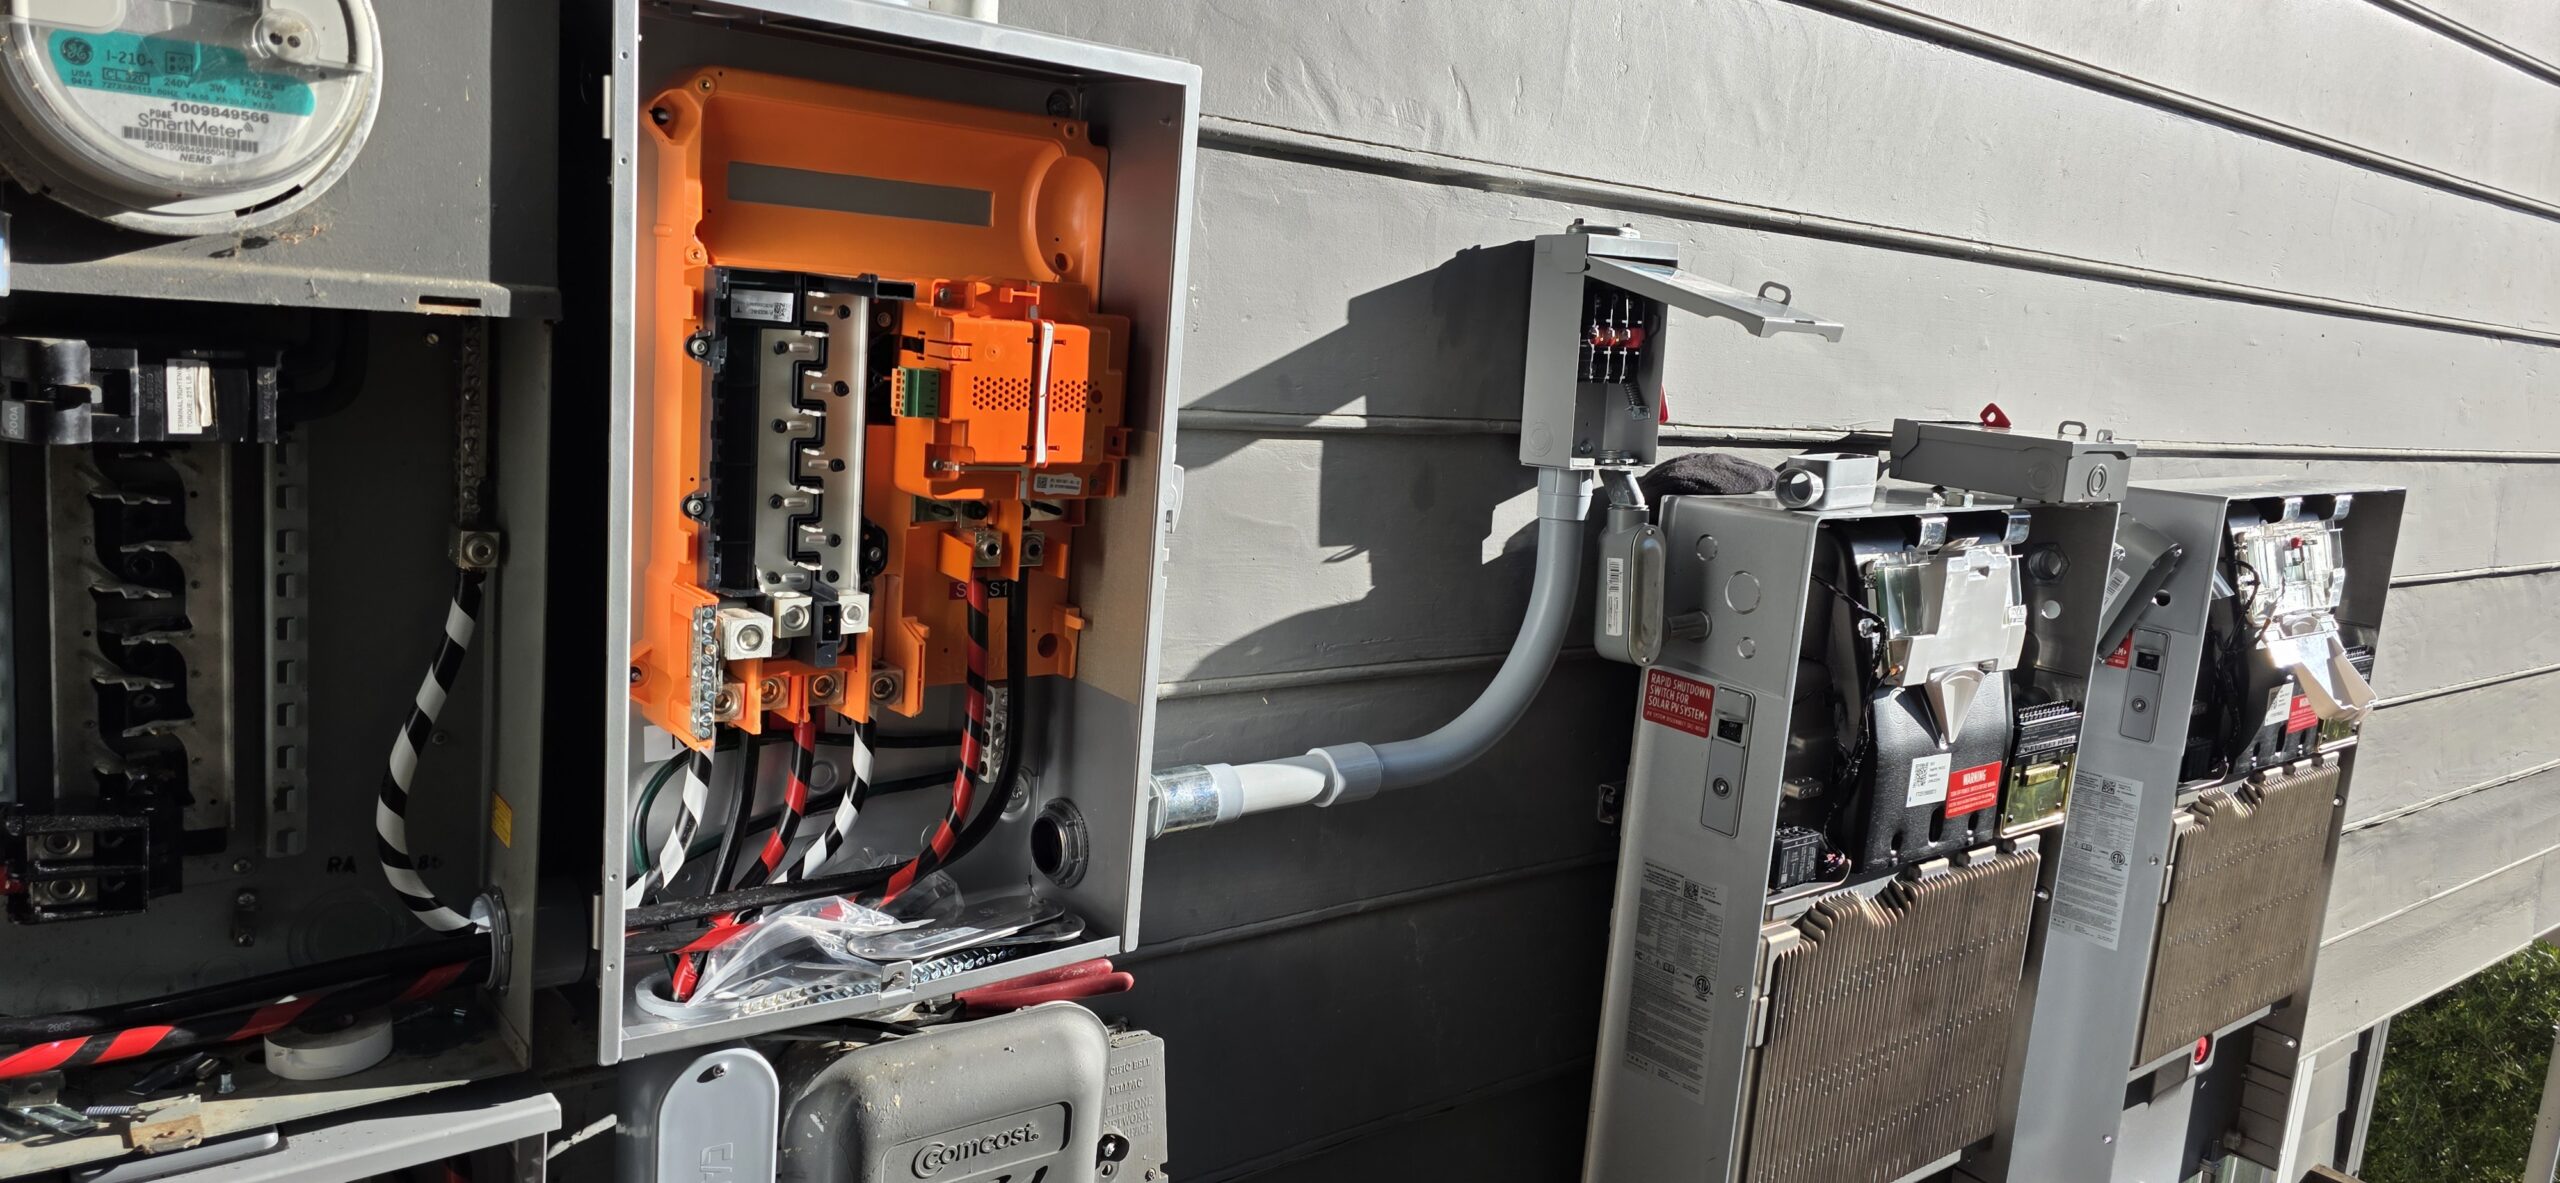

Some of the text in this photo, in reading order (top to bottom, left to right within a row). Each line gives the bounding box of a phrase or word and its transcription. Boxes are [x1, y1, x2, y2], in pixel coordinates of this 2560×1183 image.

[164, 78, 191, 89] 240V
[149, 108, 172, 119] PG&E
[171, 102, 270, 124] 1009849566
[138, 113, 243, 138] SmartMeter
[179, 153, 213, 165] NEMS
[8, 405, 19, 435] 200A
[989, 582, 1008, 597] S1
[1650, 685, 1690, 705] SWITCH FOR
[1651, 673, 1711, 699] RAPID SHUTDOWN
[1648, 695, 1705, 721] SOLAR PV SYSTEM
[326, 856, 357, 873] RA
[1109, 1057, 1151, 1076] CIFIC BELL
[1105, 1096, 1153, 1116] ELEPHONE
